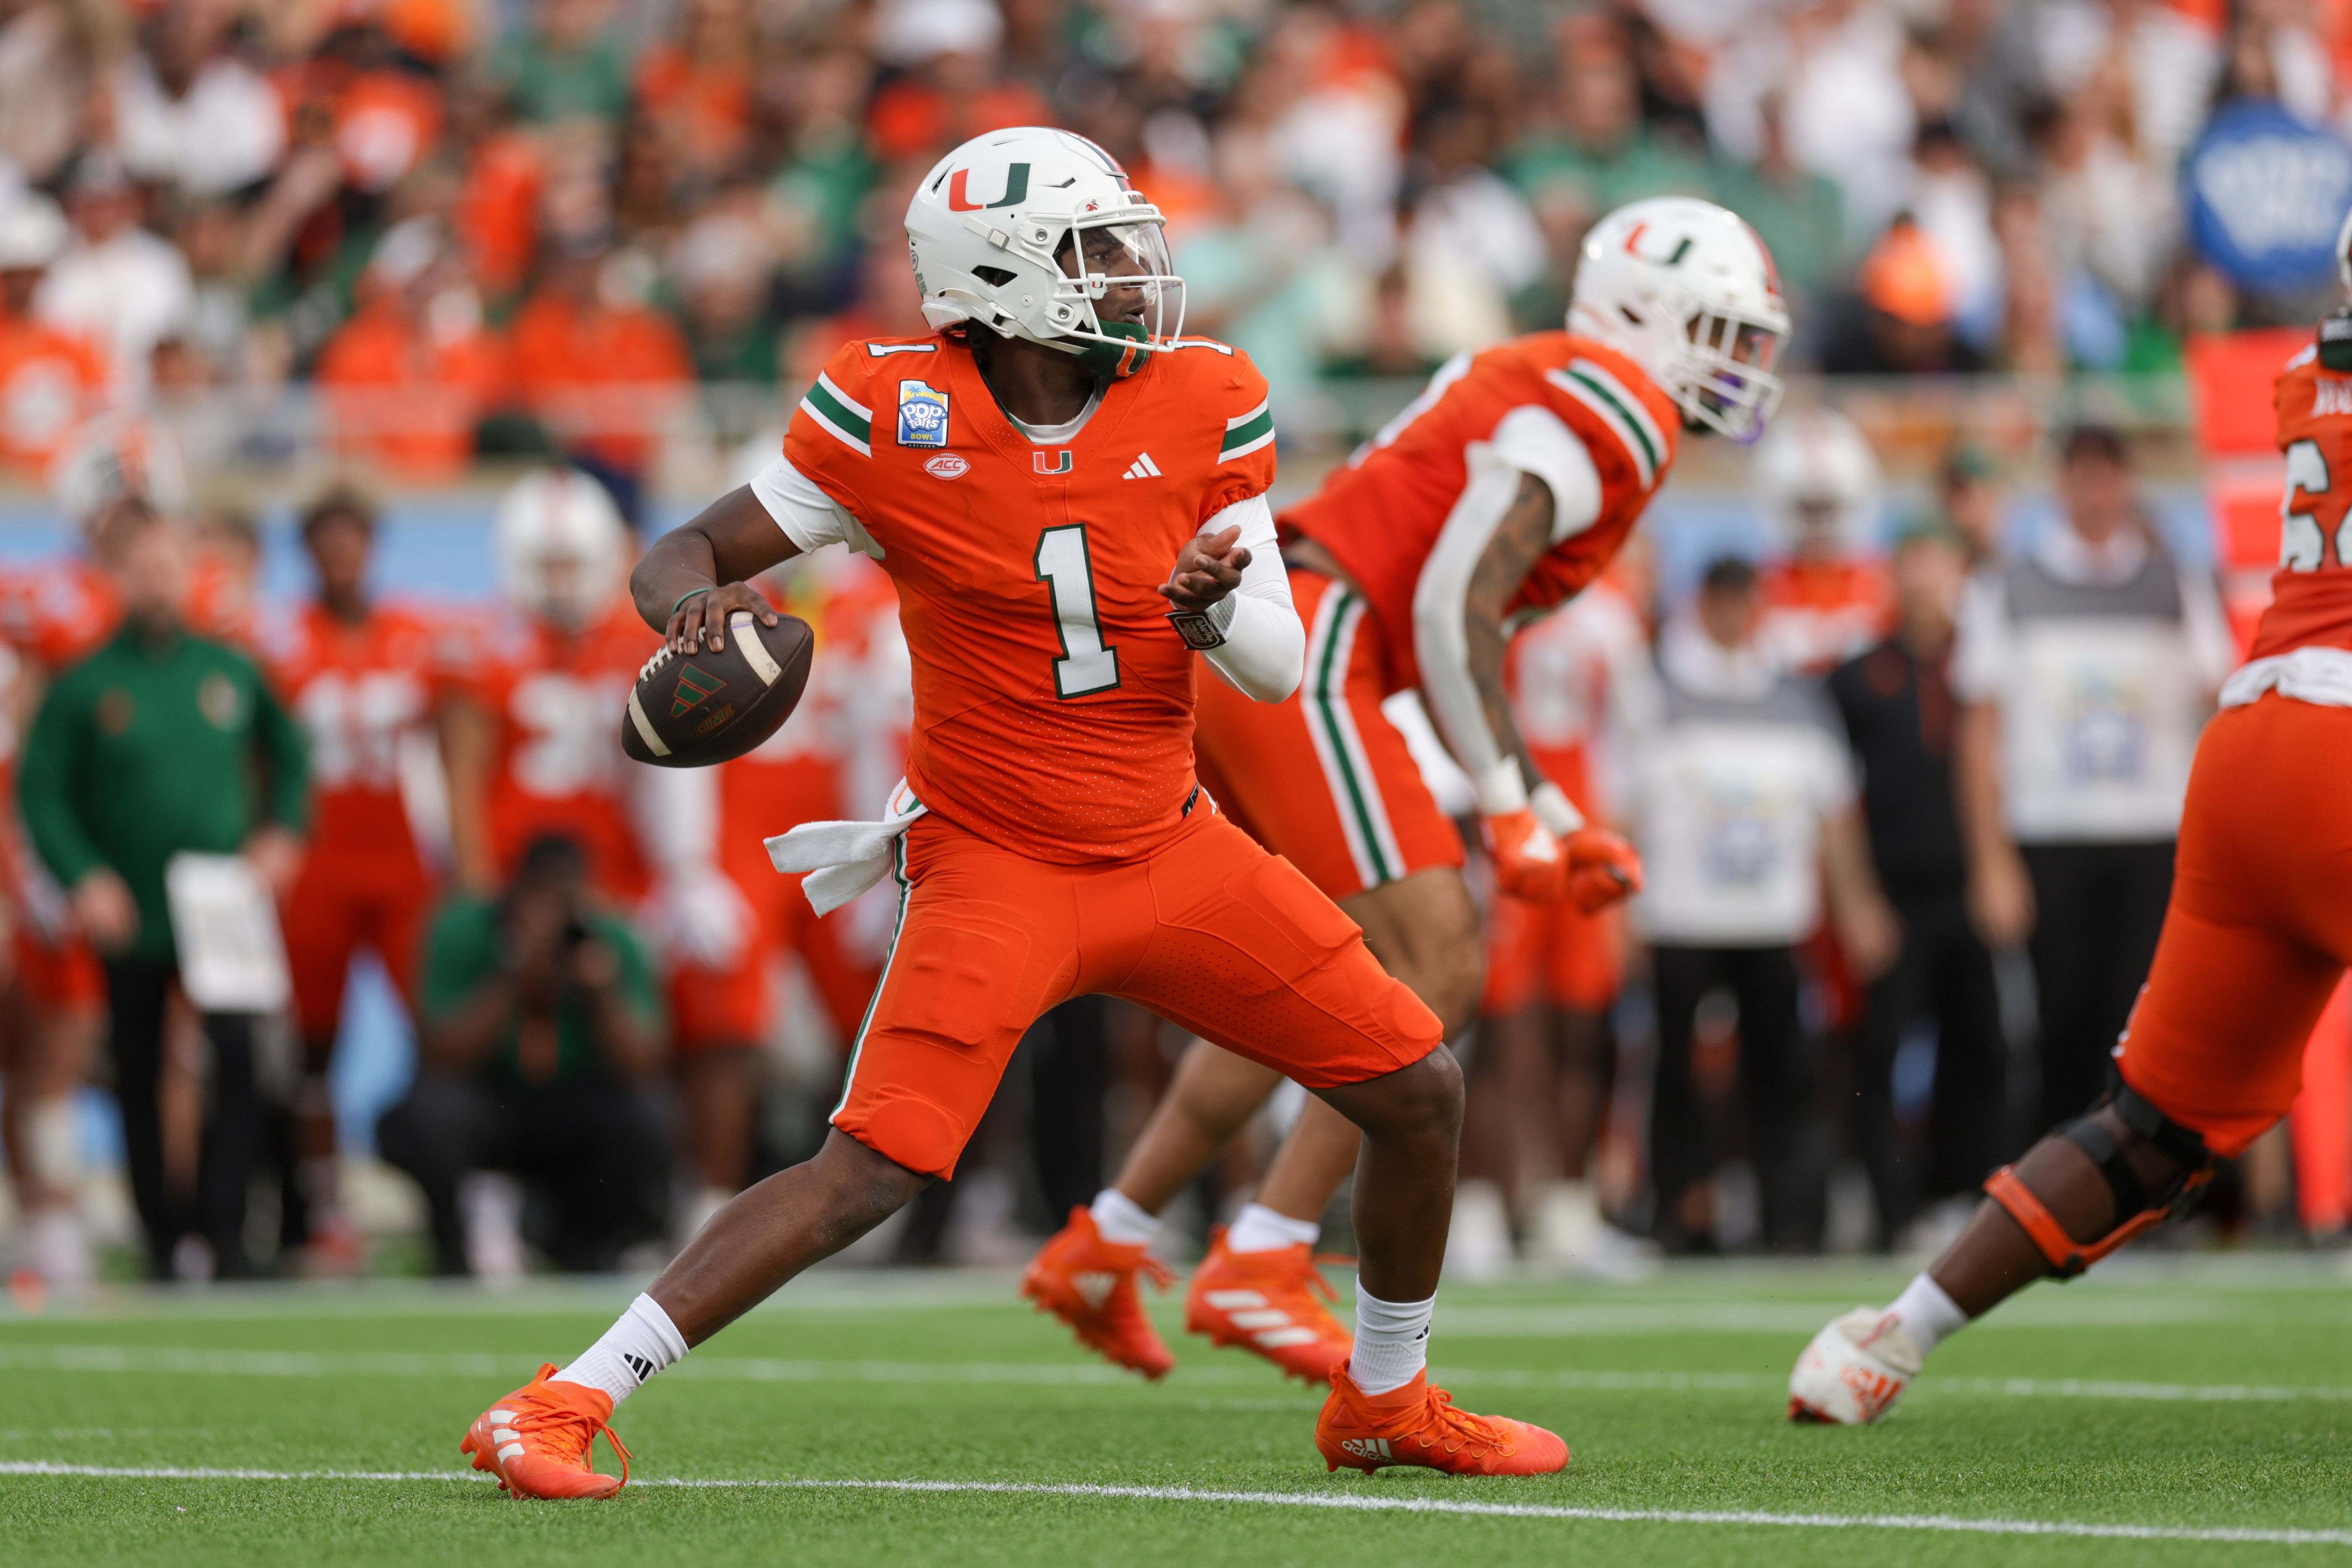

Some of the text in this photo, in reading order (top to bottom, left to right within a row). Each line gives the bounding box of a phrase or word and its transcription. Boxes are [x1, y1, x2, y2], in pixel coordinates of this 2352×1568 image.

[948, 163, 1031, 212] U
[1624, 219, 1694, 264] U
[931, 460, 964, 469] ACC
[1032, 450, 1073, 475] U
[1033, 523, 1121, 700] 1
[694, 702, 736, 738] DIME
